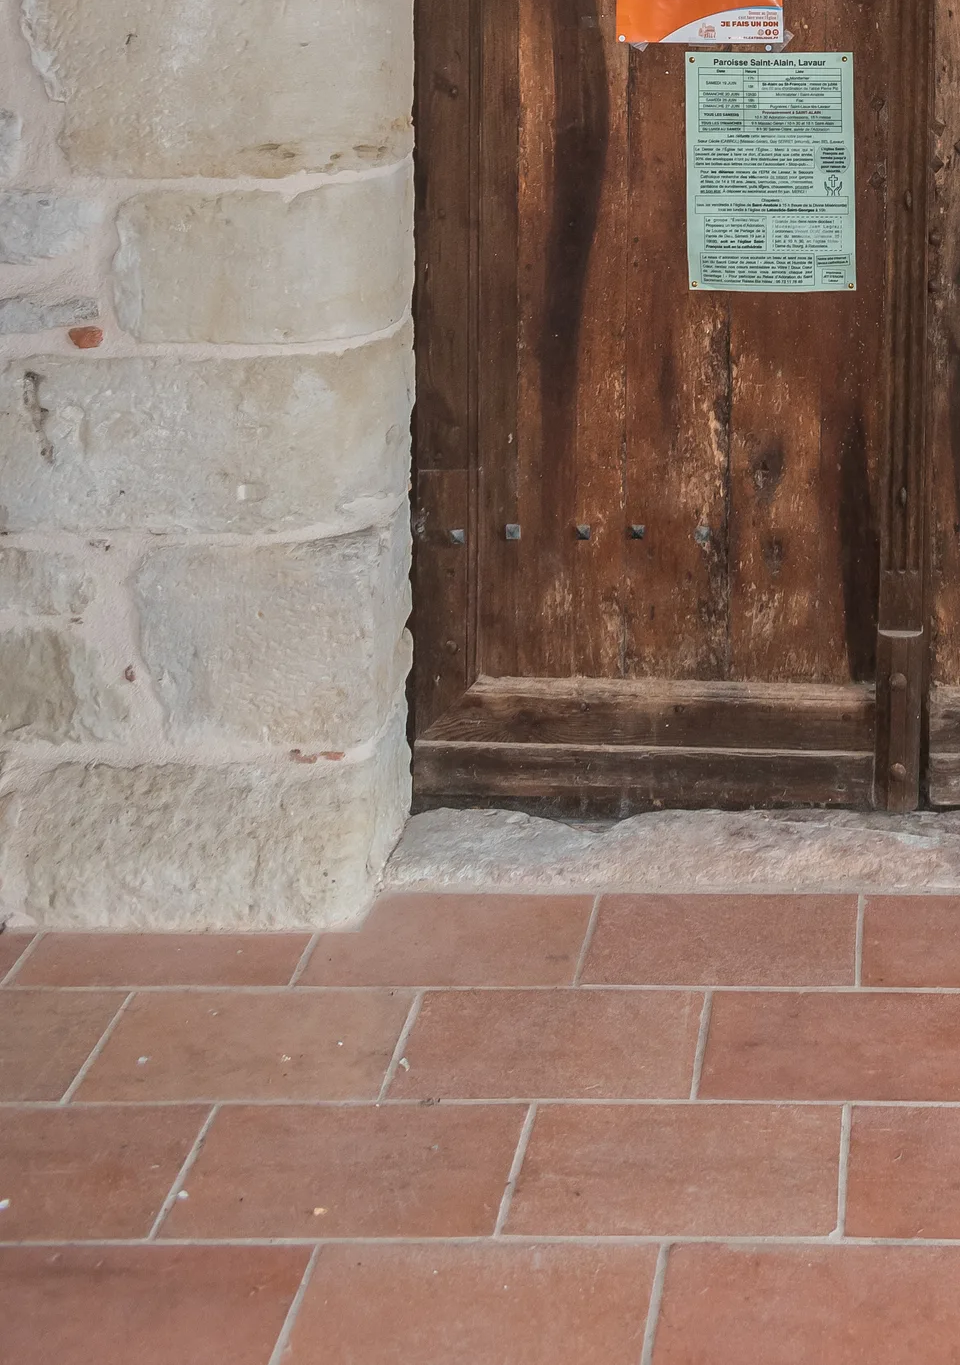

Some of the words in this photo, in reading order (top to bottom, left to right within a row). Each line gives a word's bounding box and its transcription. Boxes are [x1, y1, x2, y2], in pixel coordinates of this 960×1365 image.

[714, 59, 748, 67] Paroisse
[750, 59, 796, 67] Saint-Alain,
[798, 59, 826, 67] Lavaur
